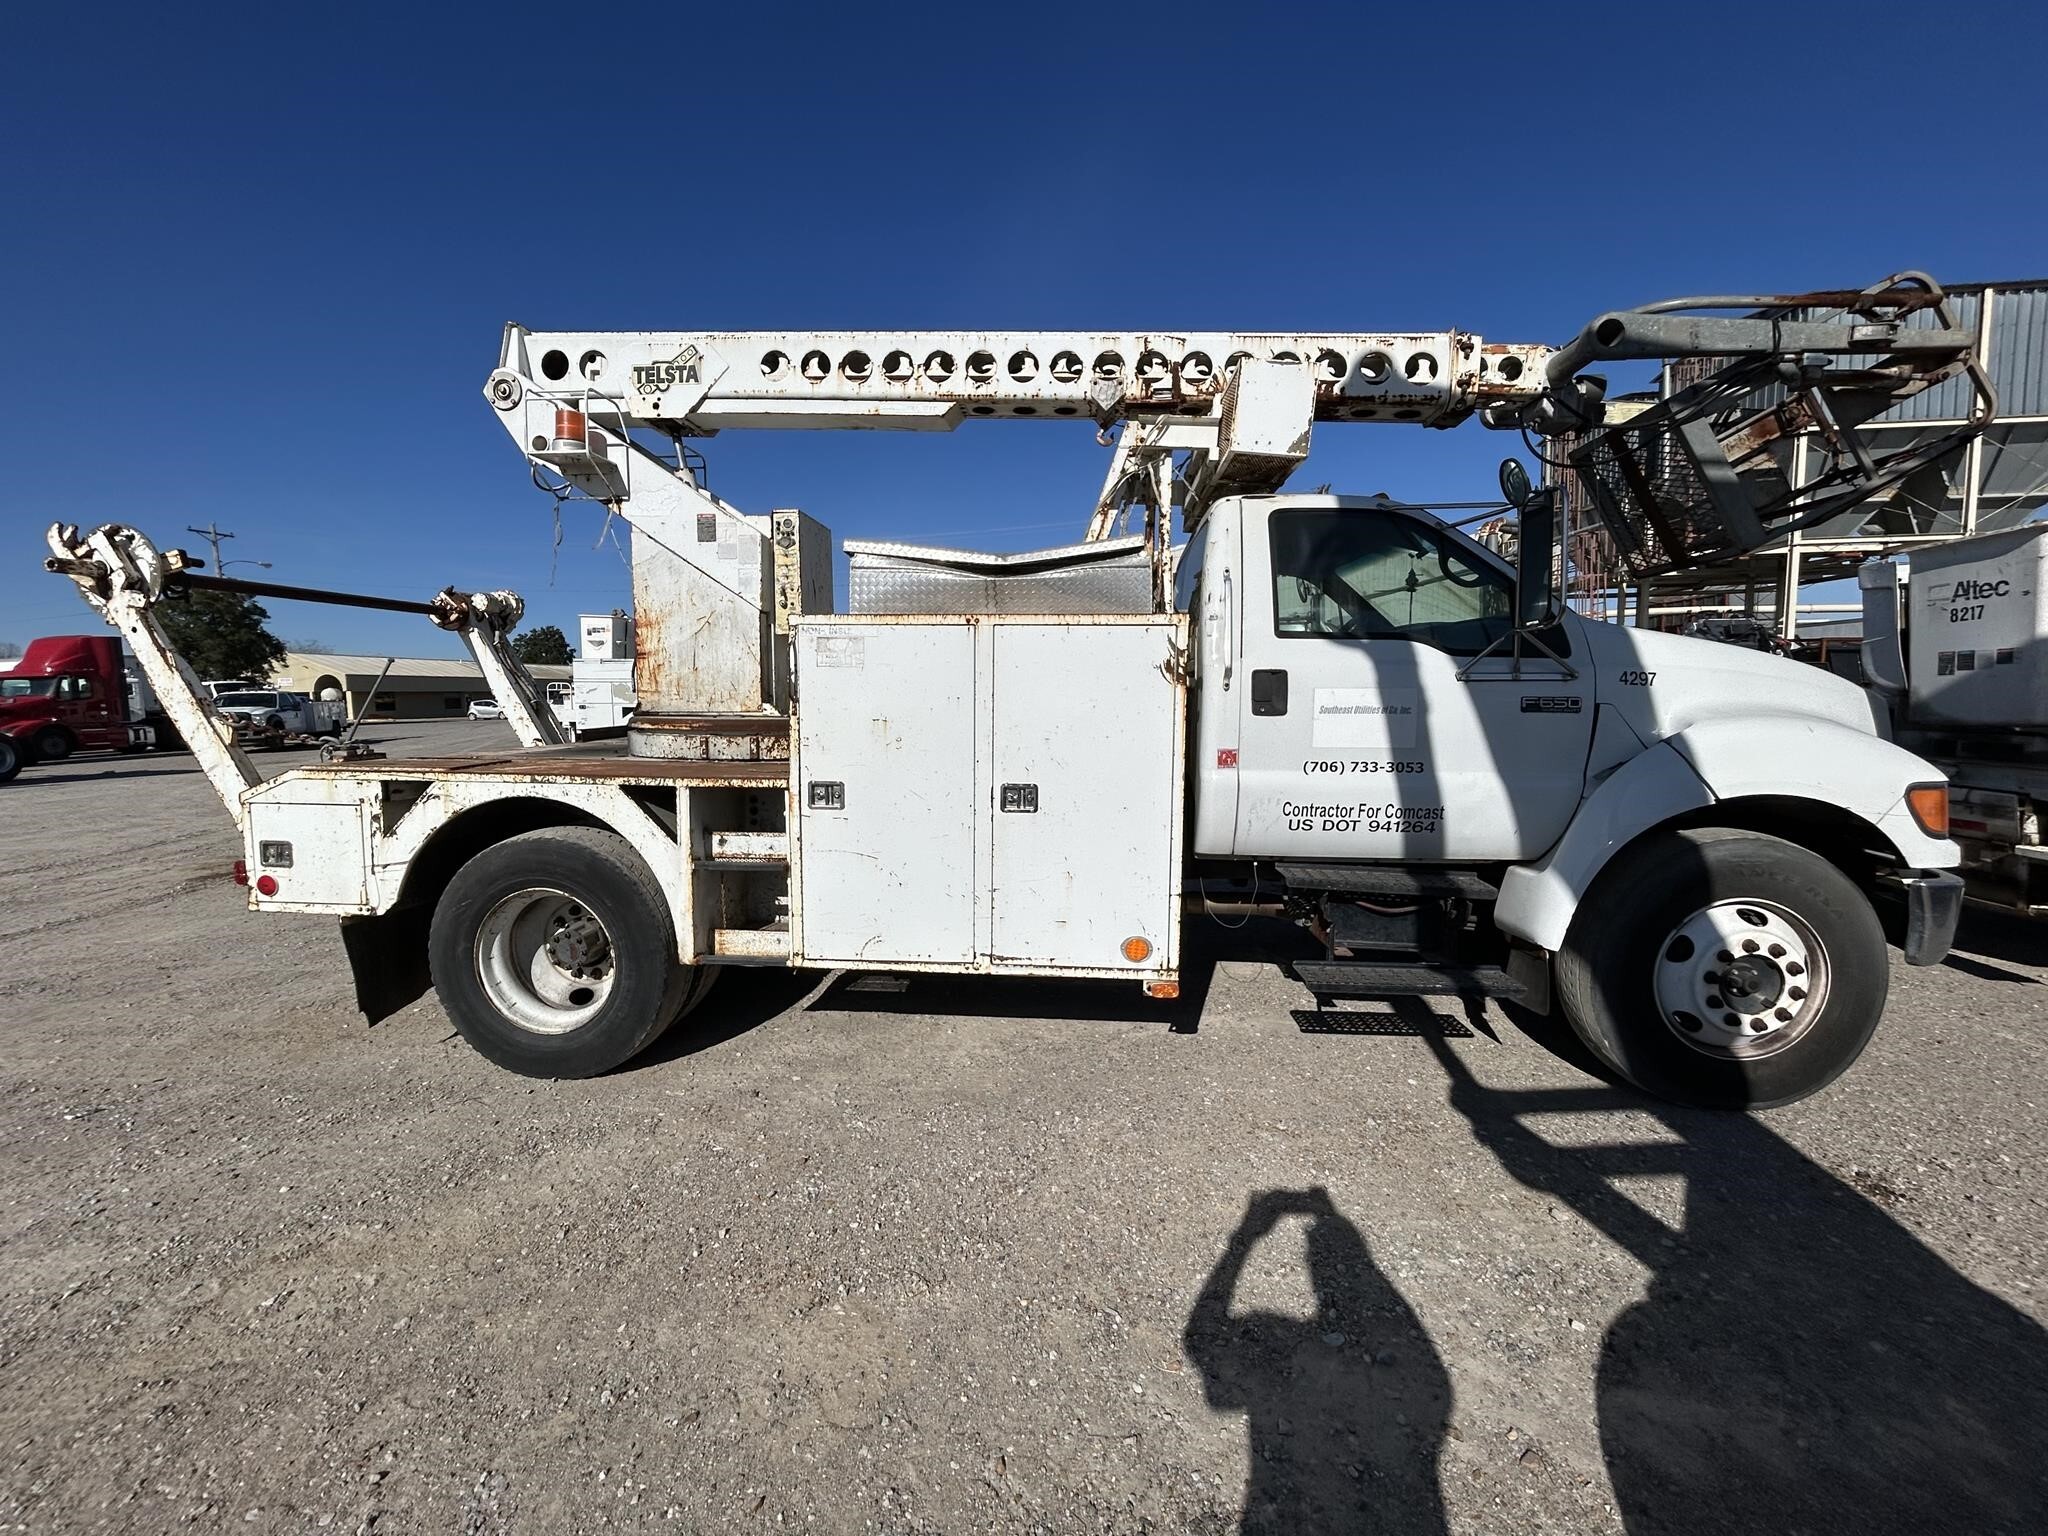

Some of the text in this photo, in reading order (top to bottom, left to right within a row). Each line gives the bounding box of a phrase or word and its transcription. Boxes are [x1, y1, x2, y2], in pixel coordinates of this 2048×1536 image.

[633, 365, 699, 384] TELSTA
[1951, 580, 2010, 602] Altec
[1950, 605, 1984, 623] 8217
[1619, 671, 1656, 686] 4297
[1319, 704, 1353, 714] Southeast
[1354, 704, 1380, 714] Utilities
[1303, 761, 1424, 775] (706) 733-3053
[1282, 801, 1445, 820] Contractor For Comcast
[1288, 819, 1435, 833] US DOT 941264
